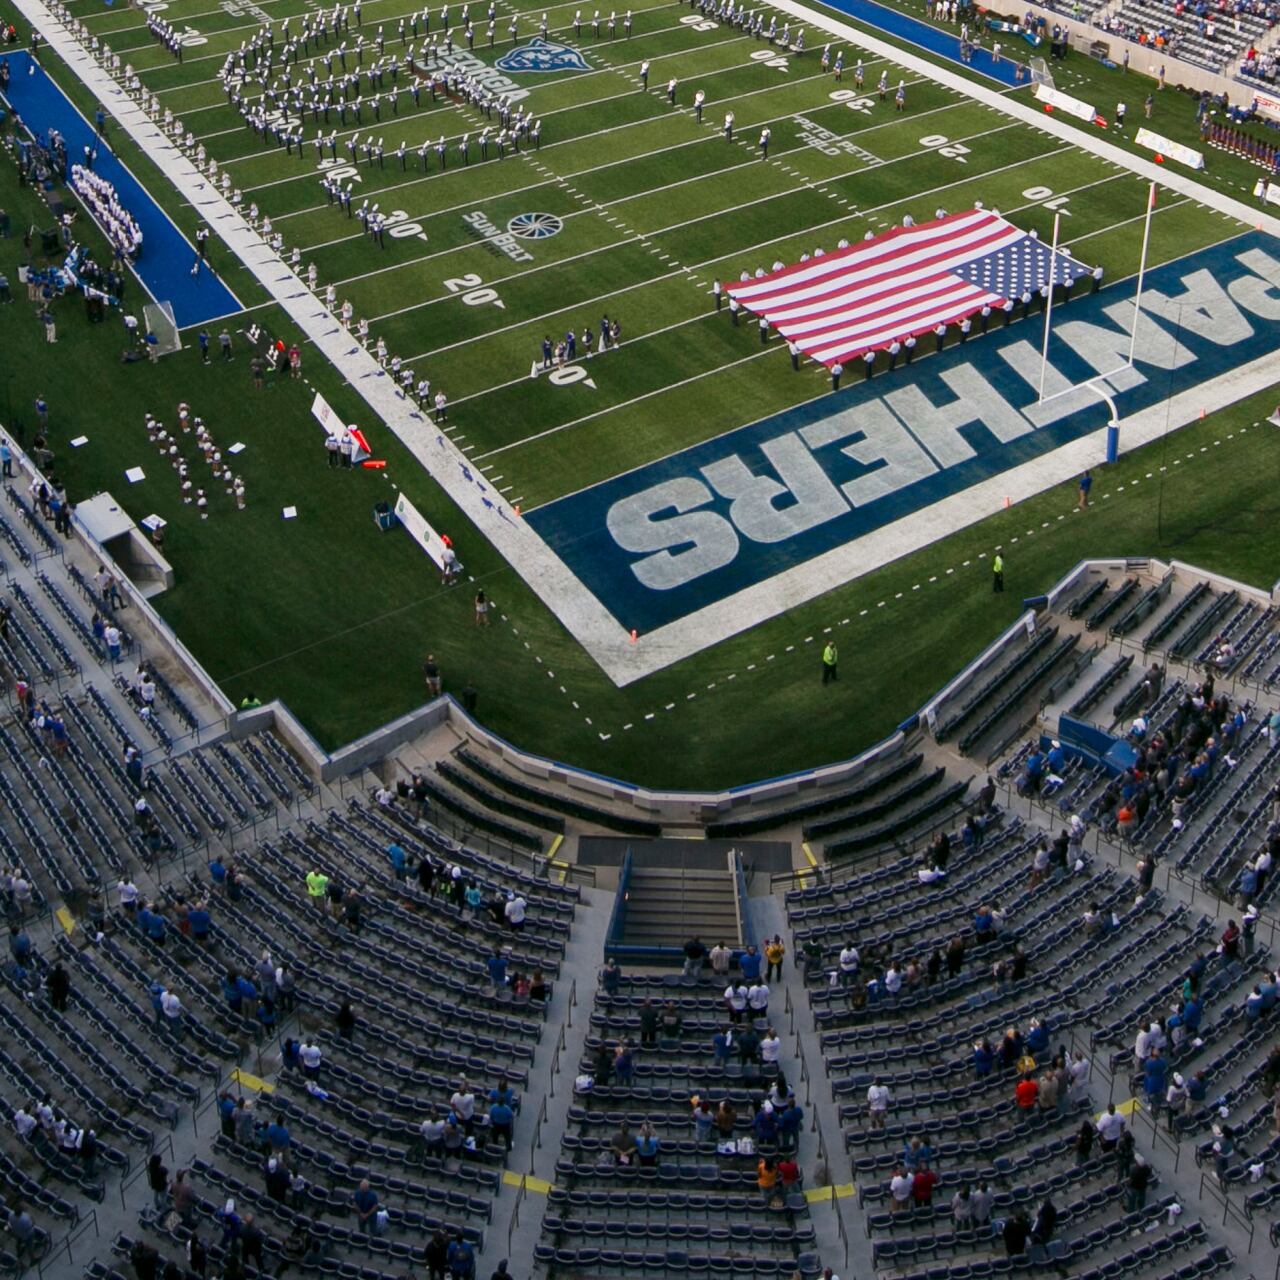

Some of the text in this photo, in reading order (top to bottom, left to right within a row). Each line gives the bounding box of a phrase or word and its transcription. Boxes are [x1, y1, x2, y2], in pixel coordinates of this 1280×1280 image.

[435, 44, 531, 103] GEORGIA
[827, 88, 877, 112] 30
[793, 113, 886, 167] PETE PETIT
[795, 131, 841, 157] FIELD
[919, 133, 972, 159] 20
[1021, 185, 1071, 211] 10
[461, 210, 535, 263] SUN BELT
[443, 272, 500, 307] 20
